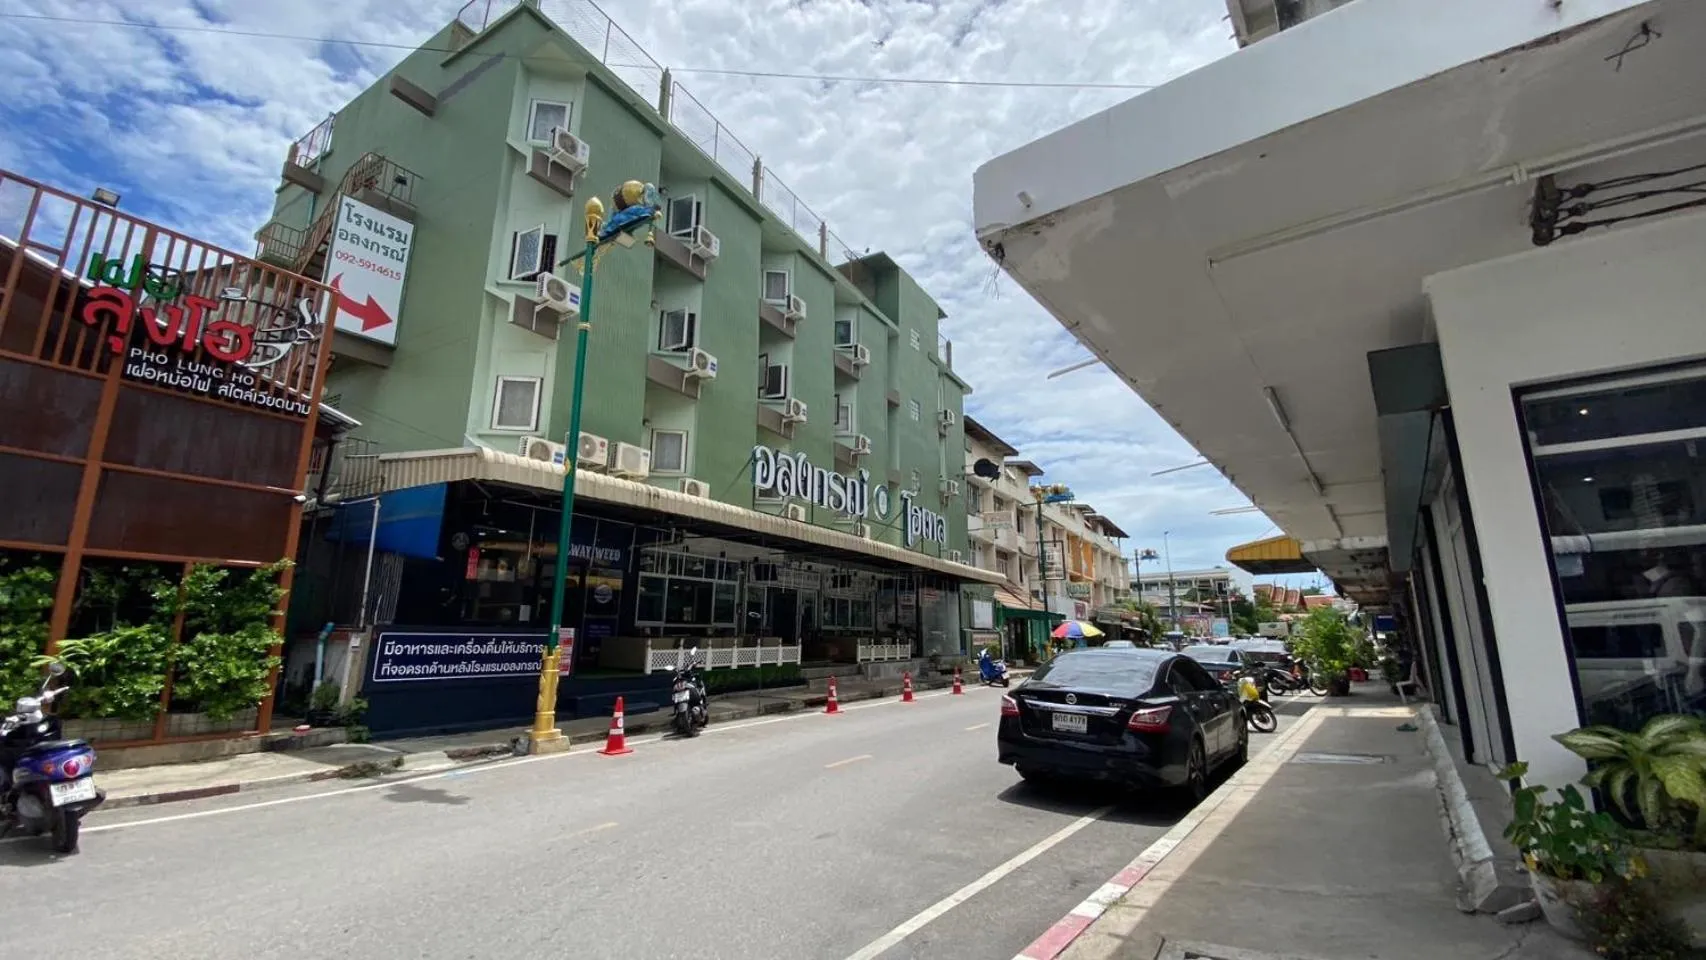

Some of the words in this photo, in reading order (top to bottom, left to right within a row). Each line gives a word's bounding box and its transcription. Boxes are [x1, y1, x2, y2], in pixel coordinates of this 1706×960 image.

[344, 202, 409, 245] โรงแรม
[338, 228, 408, 263] อลงกรณ์
[335, 250, 402, 281] 092-5914615
[82, 286, 257, 363] ลุงโฮ
[130, 347, 168, 364] PHO
[177, 359, 224, 378] LUNG
[231, 372, 254, 386] HO
[218, 383, 312, 415] สไตล์เวียดนาม
[752, 445, 870, 519] อลงกรณ์
